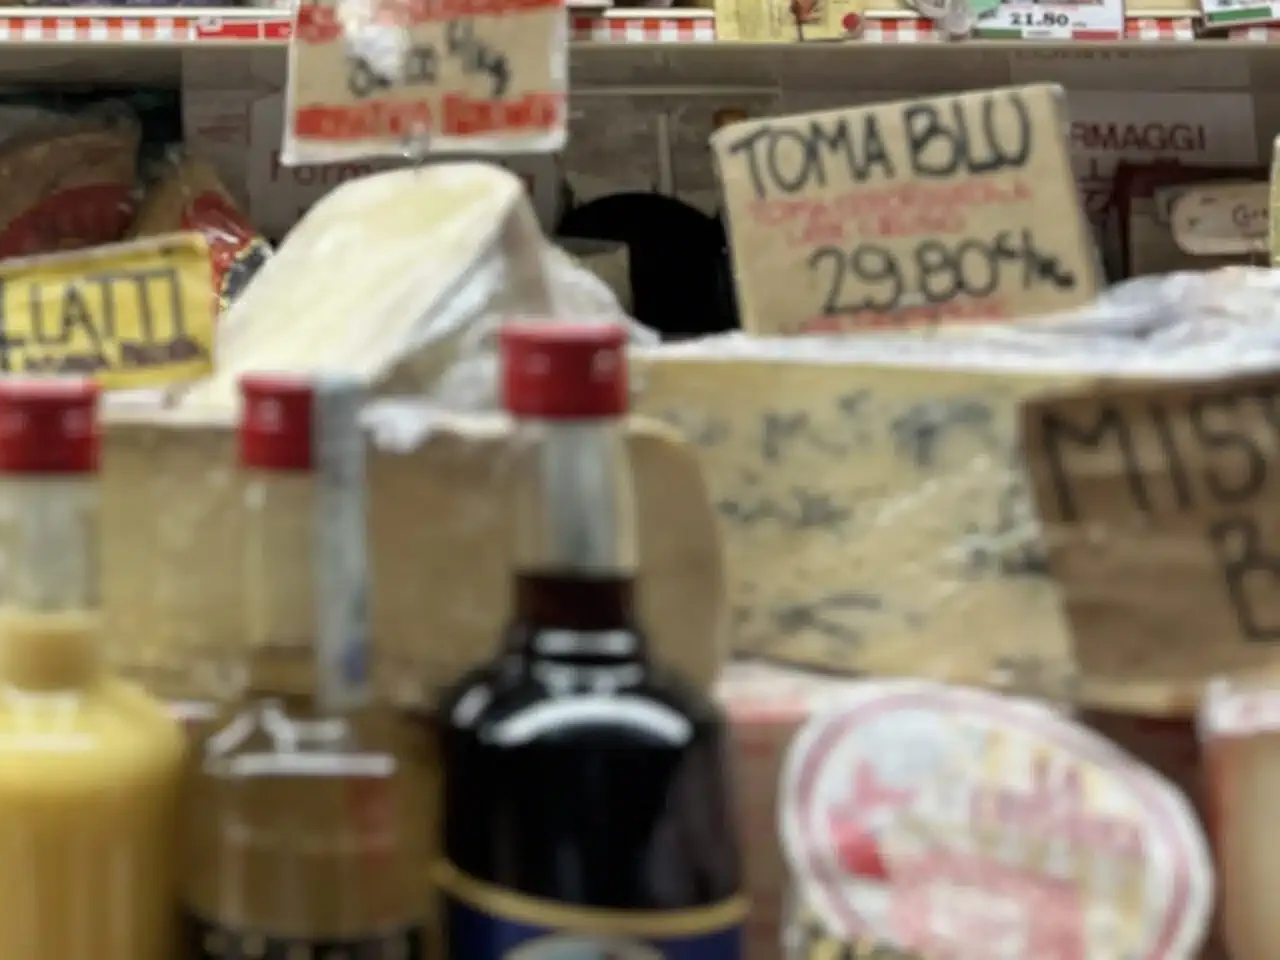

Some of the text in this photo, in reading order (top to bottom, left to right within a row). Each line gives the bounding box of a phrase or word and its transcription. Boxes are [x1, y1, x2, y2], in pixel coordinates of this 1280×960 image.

[1010, 11, 1069, 27] 21.80
[729, 93, 1031, 197] TOMA BLU
